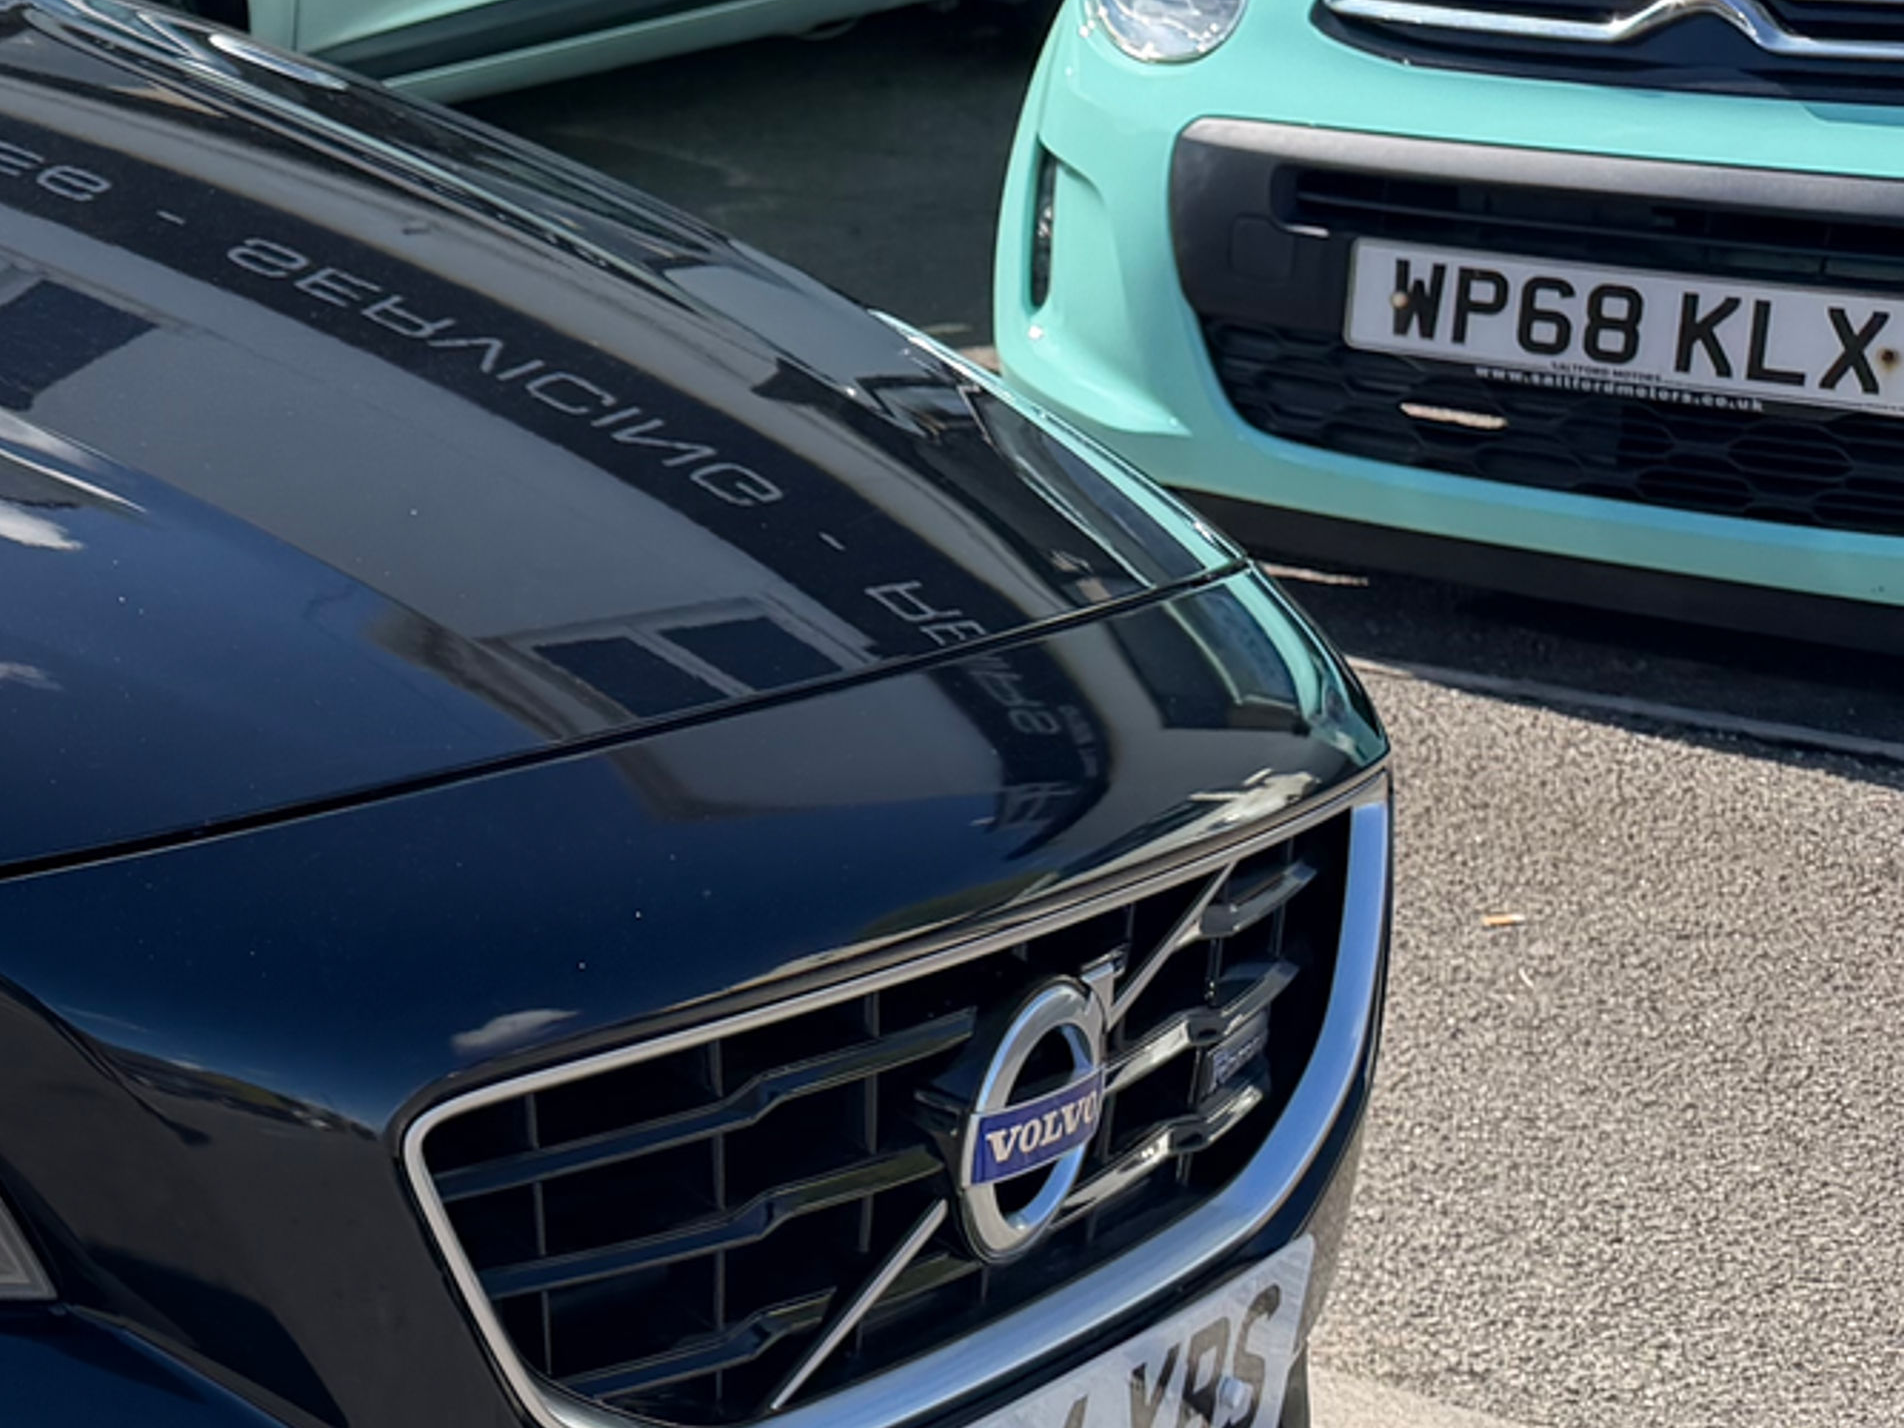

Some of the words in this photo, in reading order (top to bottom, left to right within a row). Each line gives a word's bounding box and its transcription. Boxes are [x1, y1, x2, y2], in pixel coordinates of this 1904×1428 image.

[1392, 259, 1643, 366] WP68
[1674, 290, 1891, 396] KLX
[985, 1089, 1098, 1164] VOLVO
